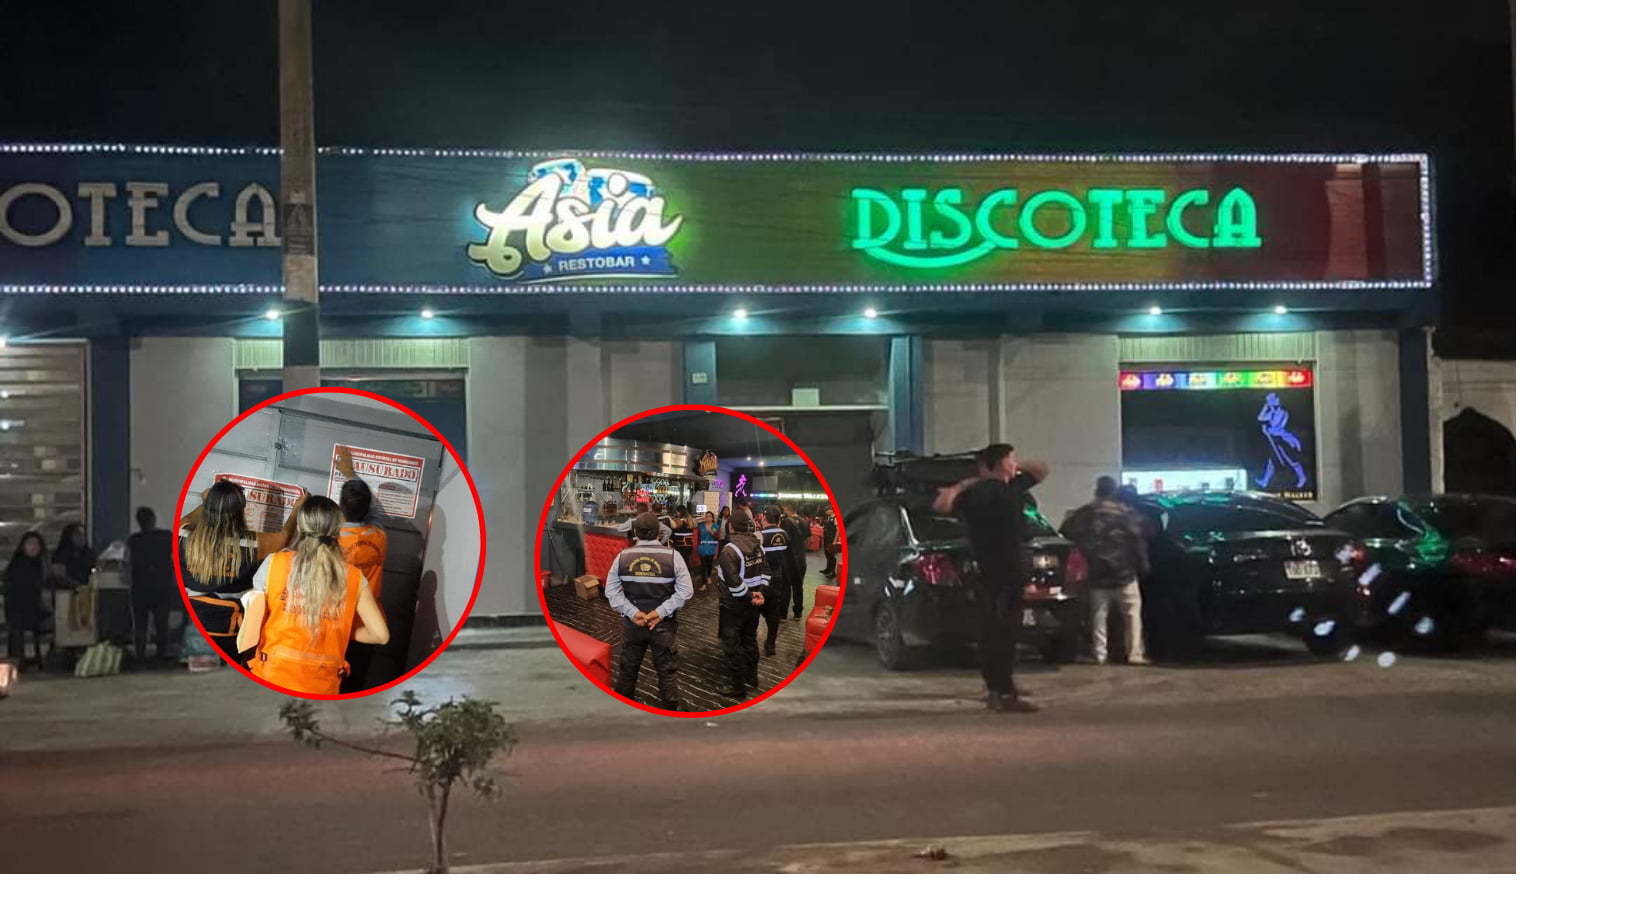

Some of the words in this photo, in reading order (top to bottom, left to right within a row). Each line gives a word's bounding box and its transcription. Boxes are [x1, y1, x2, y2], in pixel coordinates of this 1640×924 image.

[467, 172, 684, 274] Asia
[852, 187, 1262, 268] DISCOTECA
[558, 256, 635, 272] RESTOBAR
[353, 461, 416, 480] AUSURADO
